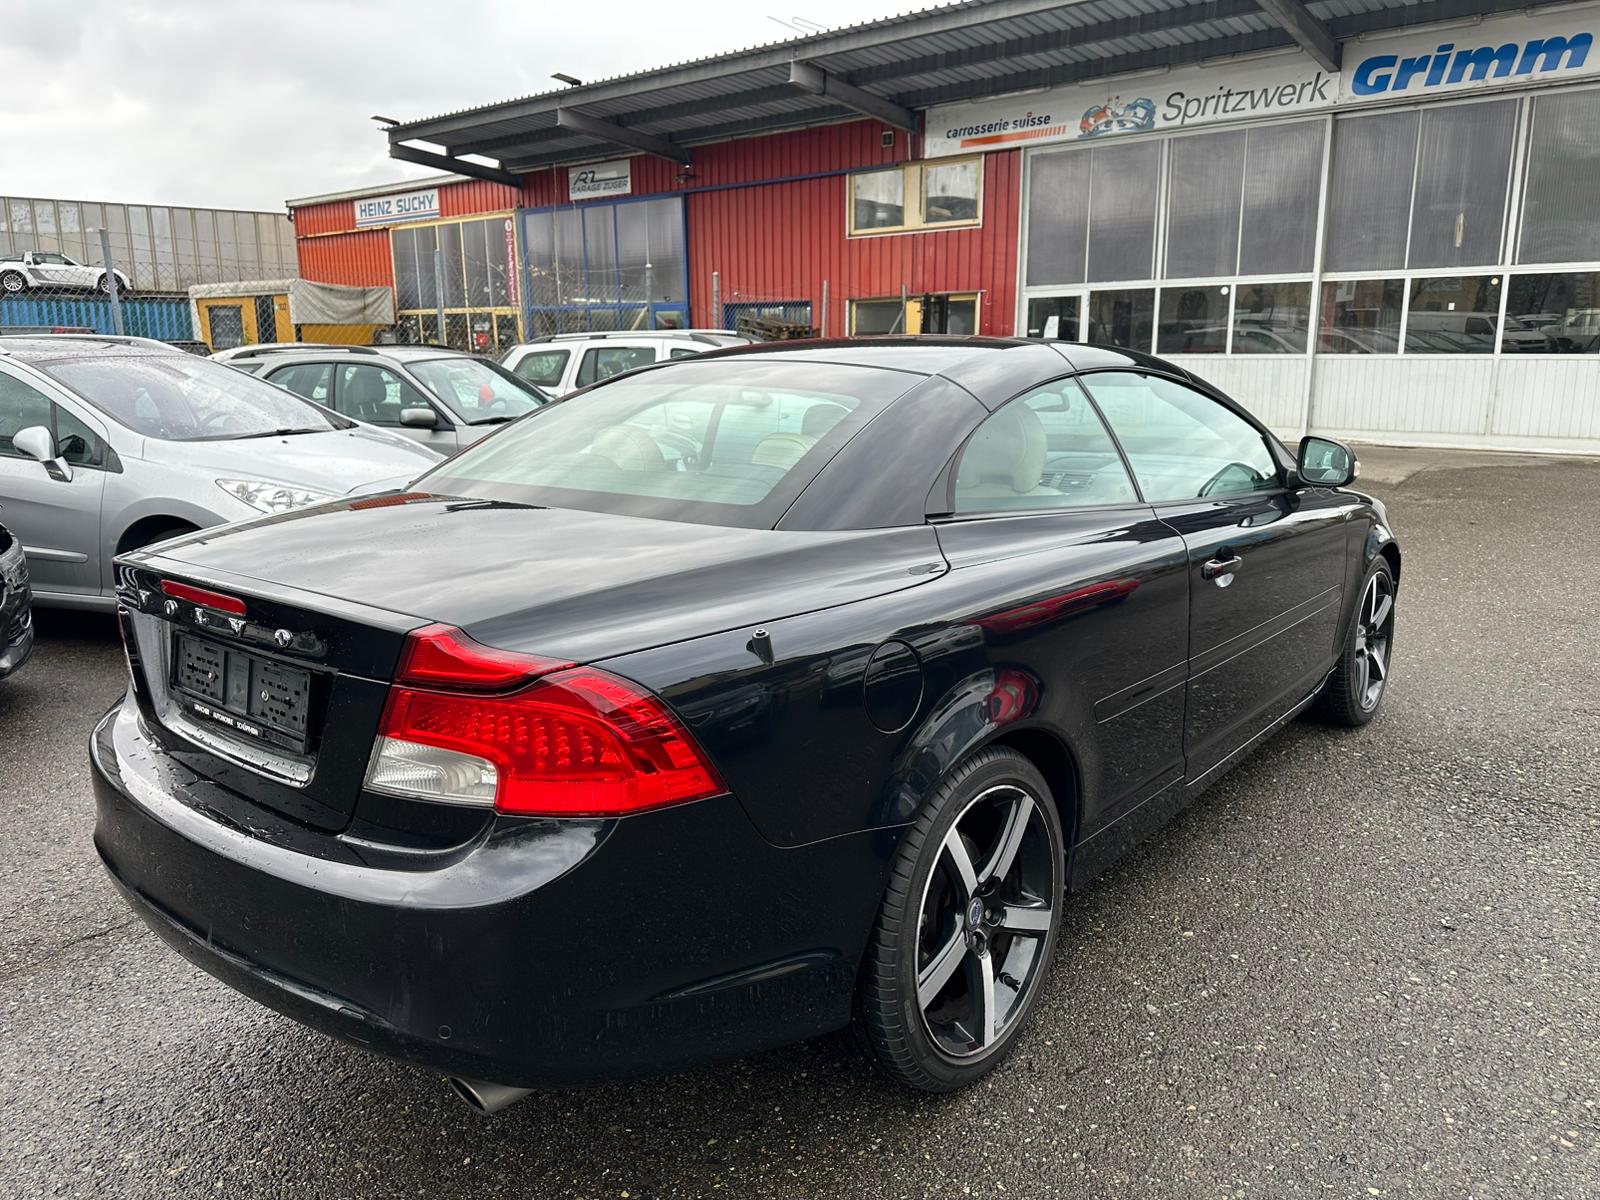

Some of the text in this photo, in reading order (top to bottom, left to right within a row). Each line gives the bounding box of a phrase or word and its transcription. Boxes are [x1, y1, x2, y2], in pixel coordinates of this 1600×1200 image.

[1352, 32, 1593, 96] Grimm
[1162, 72, 1331, 125] Spritzwerk
[946, 112, 1051, 139] carrosserie suisse
[571, 183, 601, 194] GARAGE
[360, 194, 434, 218] HEINZ SUCHY
